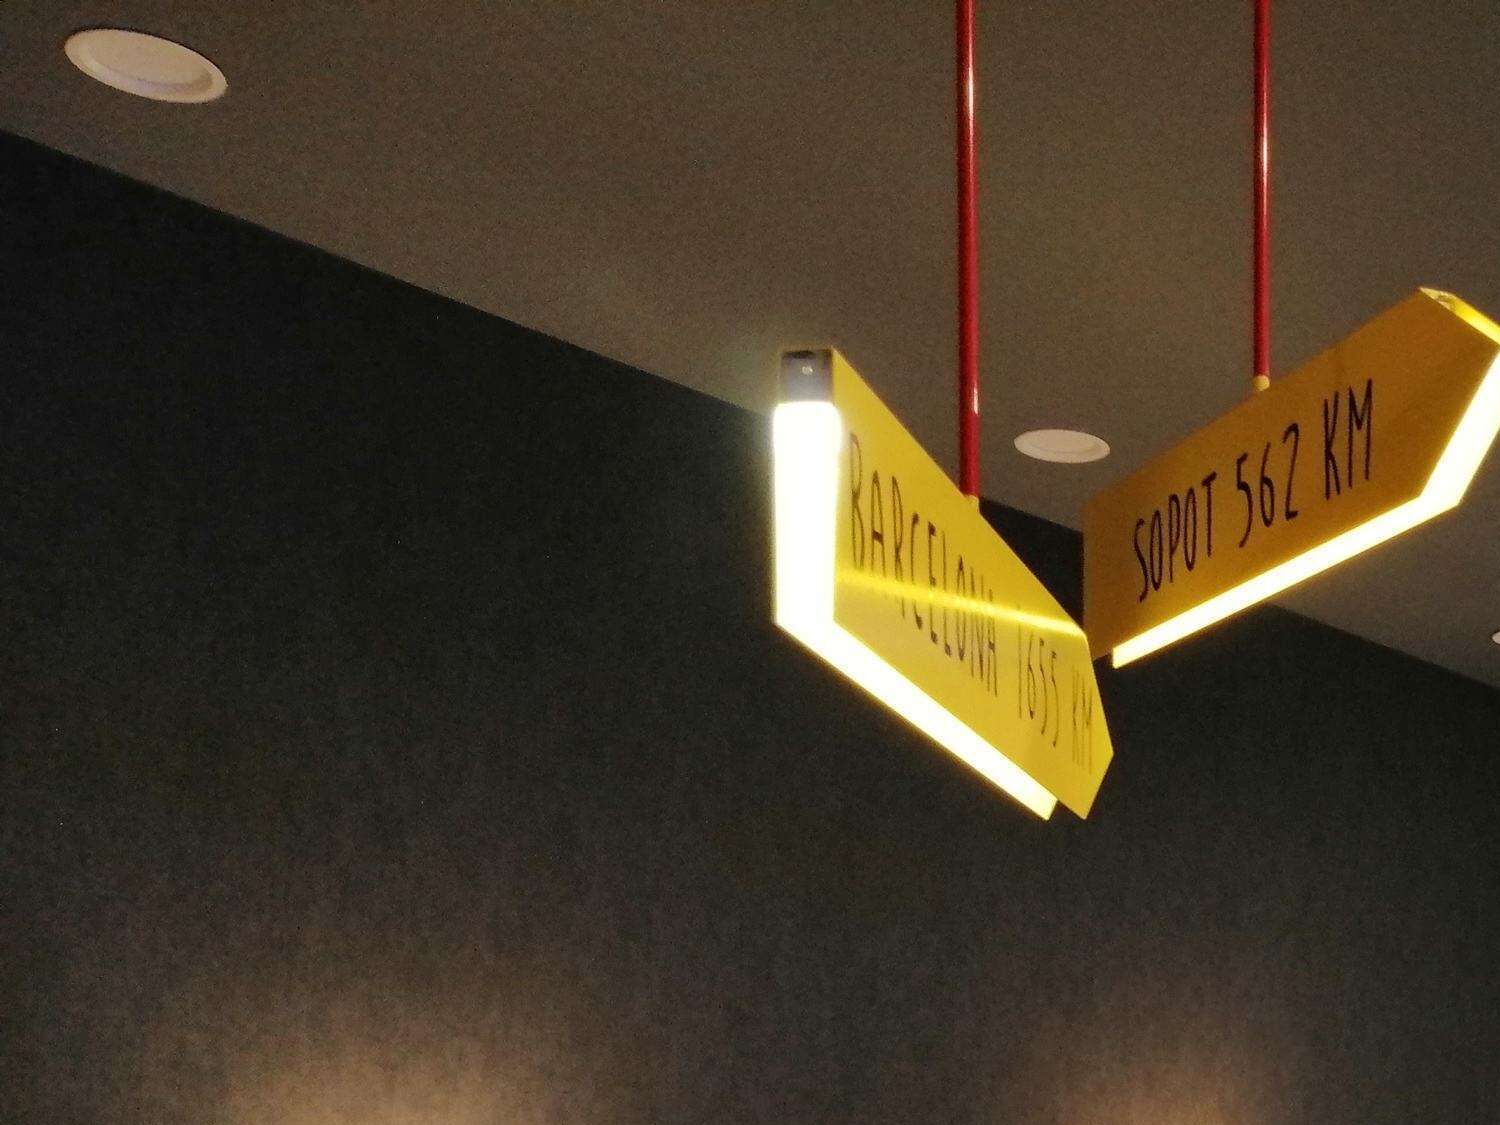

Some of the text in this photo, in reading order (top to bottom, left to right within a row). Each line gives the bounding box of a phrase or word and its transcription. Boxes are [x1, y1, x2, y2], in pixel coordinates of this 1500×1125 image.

[850, 432, 1094, 776] BARCELONA 1655 KM
[1133, 378, 1373, 602] SOPOT 562 KM
